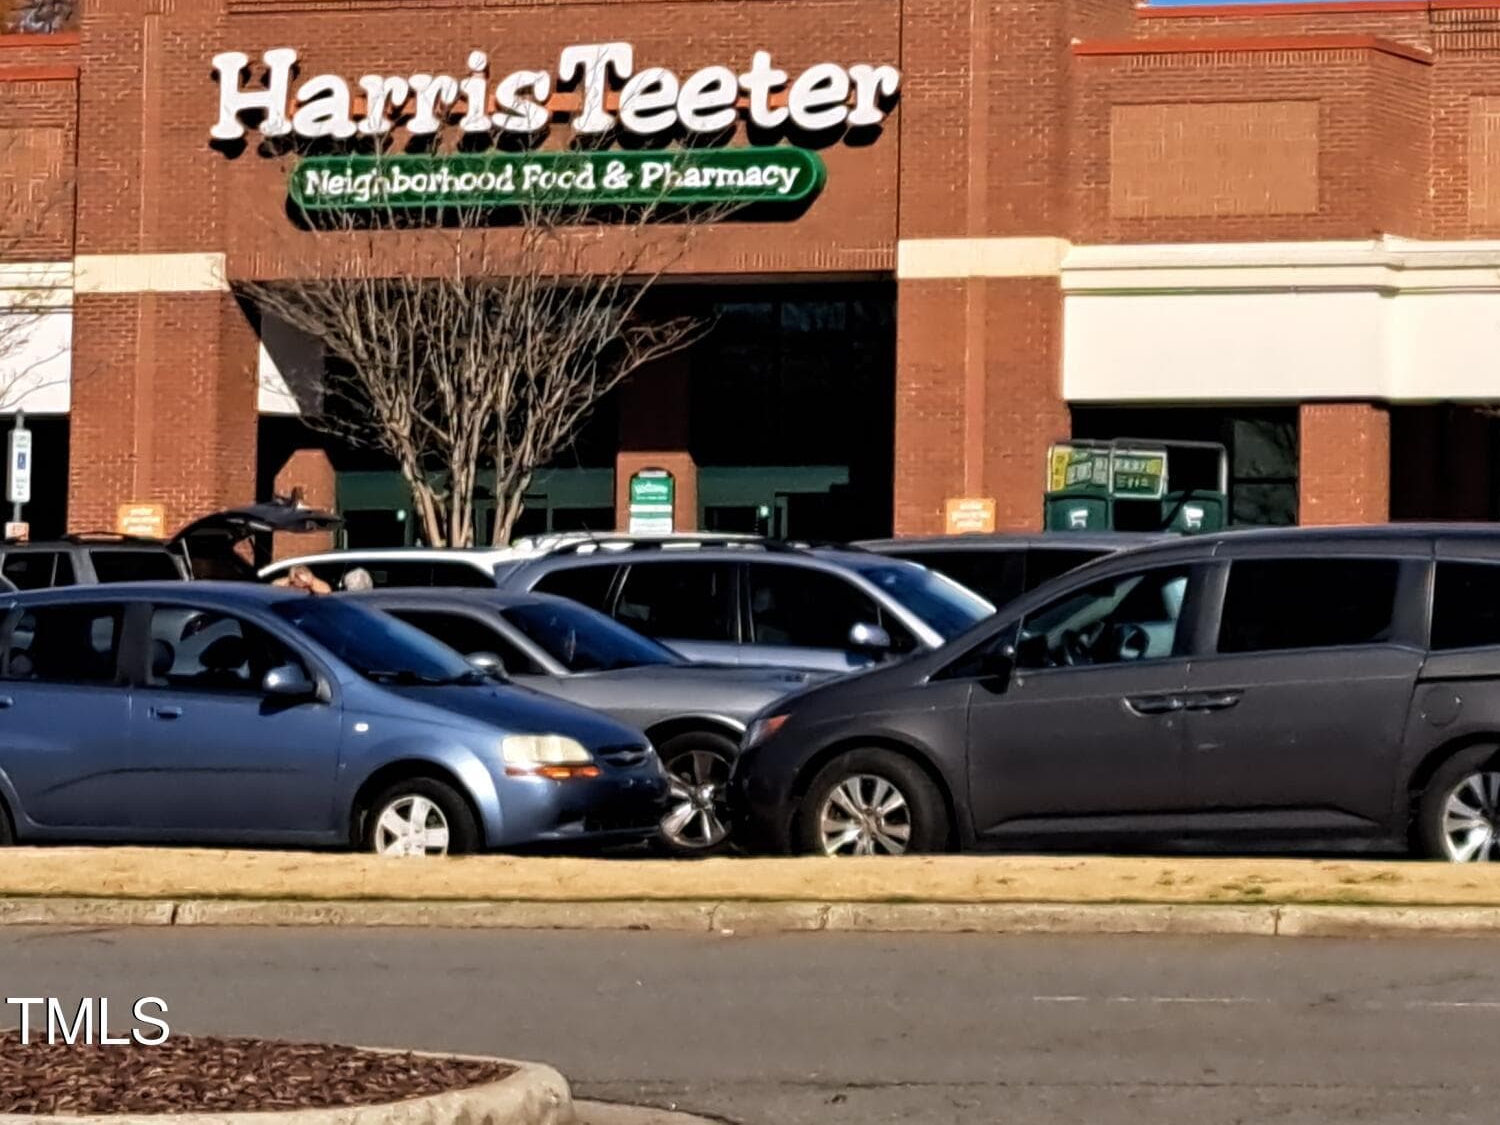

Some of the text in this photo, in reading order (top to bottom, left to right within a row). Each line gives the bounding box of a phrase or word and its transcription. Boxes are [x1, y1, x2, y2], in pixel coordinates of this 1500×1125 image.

[210, 42, 900, 139] Harris Teeter
[304, 159, 801, 203] Neighborhood Food & Pharmacy
